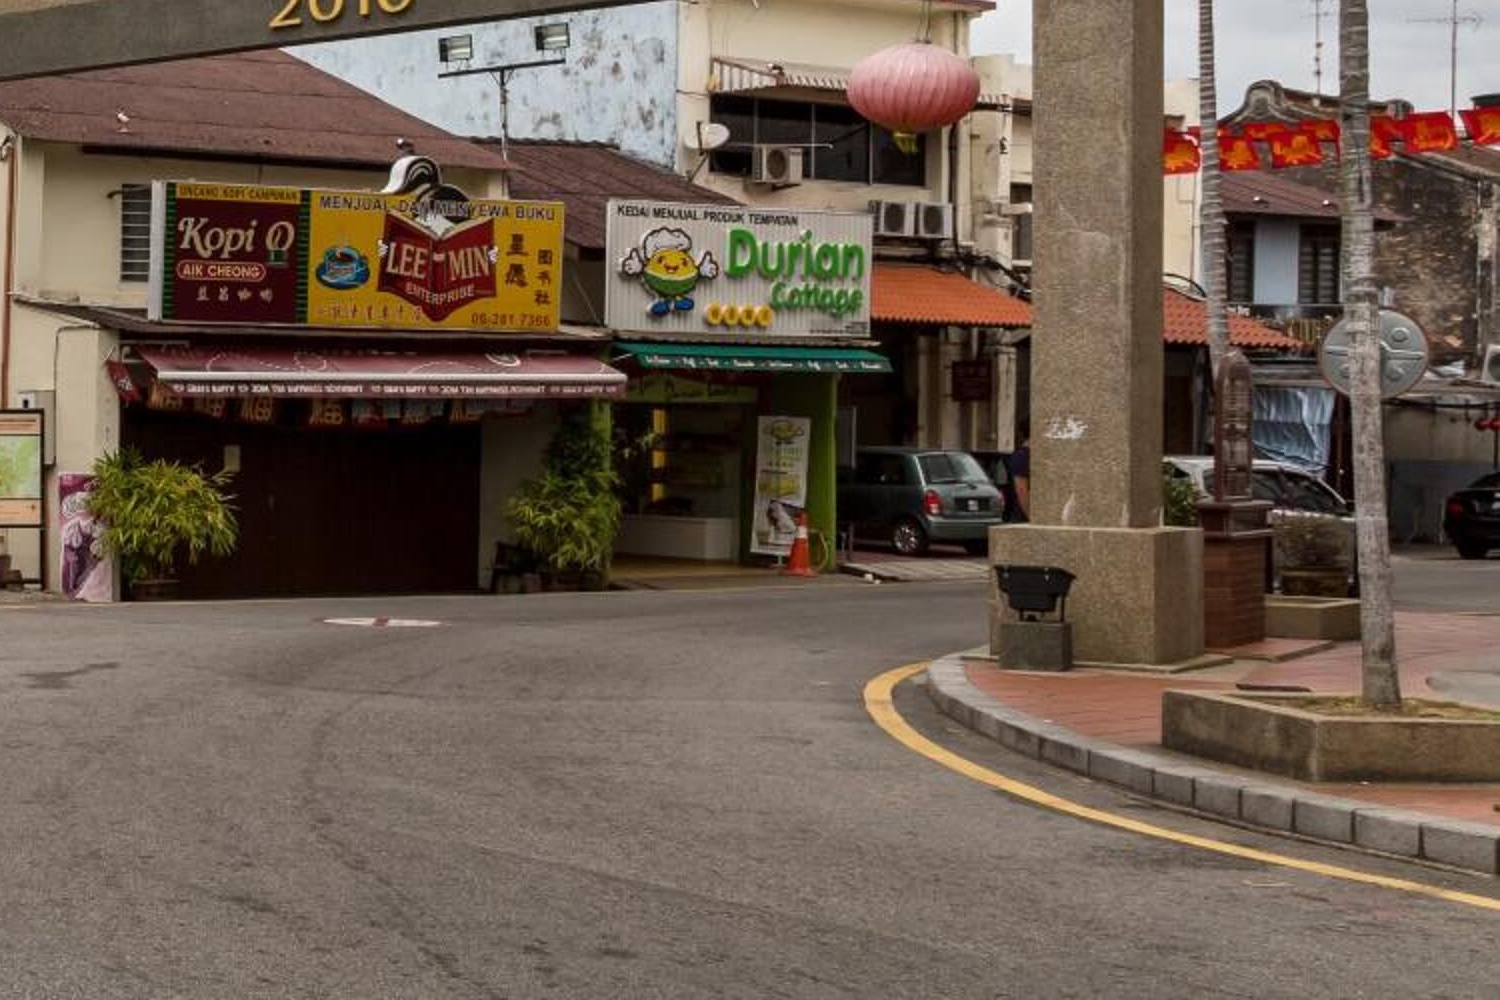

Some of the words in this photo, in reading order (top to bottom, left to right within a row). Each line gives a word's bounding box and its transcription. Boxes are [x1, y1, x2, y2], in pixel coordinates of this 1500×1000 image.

[320, 196, 390, 213] MENJUAL
[516, 205, 555, 220] BUKU
[617, 204, 649, 218] KEDAI
[652, 207, 699, 222] MENJUAL
[703, 210, 744, 224] PRODUK
[748, 212, 799, 226] TEMPATAN
[178, 217, 258, 259] Kopi
[266, 221, 295, 252] O
[385, 242, 427, 279] LEE
[450, 245, 491, 281] MIN
[726, 229, 864, 281] Durian
[183, 263, 203, 276] AIK
[207, 264, 261, 278] CHEONG
[405, 281, 475, 304] ENTERPRISE
[771, 281, 863, 315] Cottage
